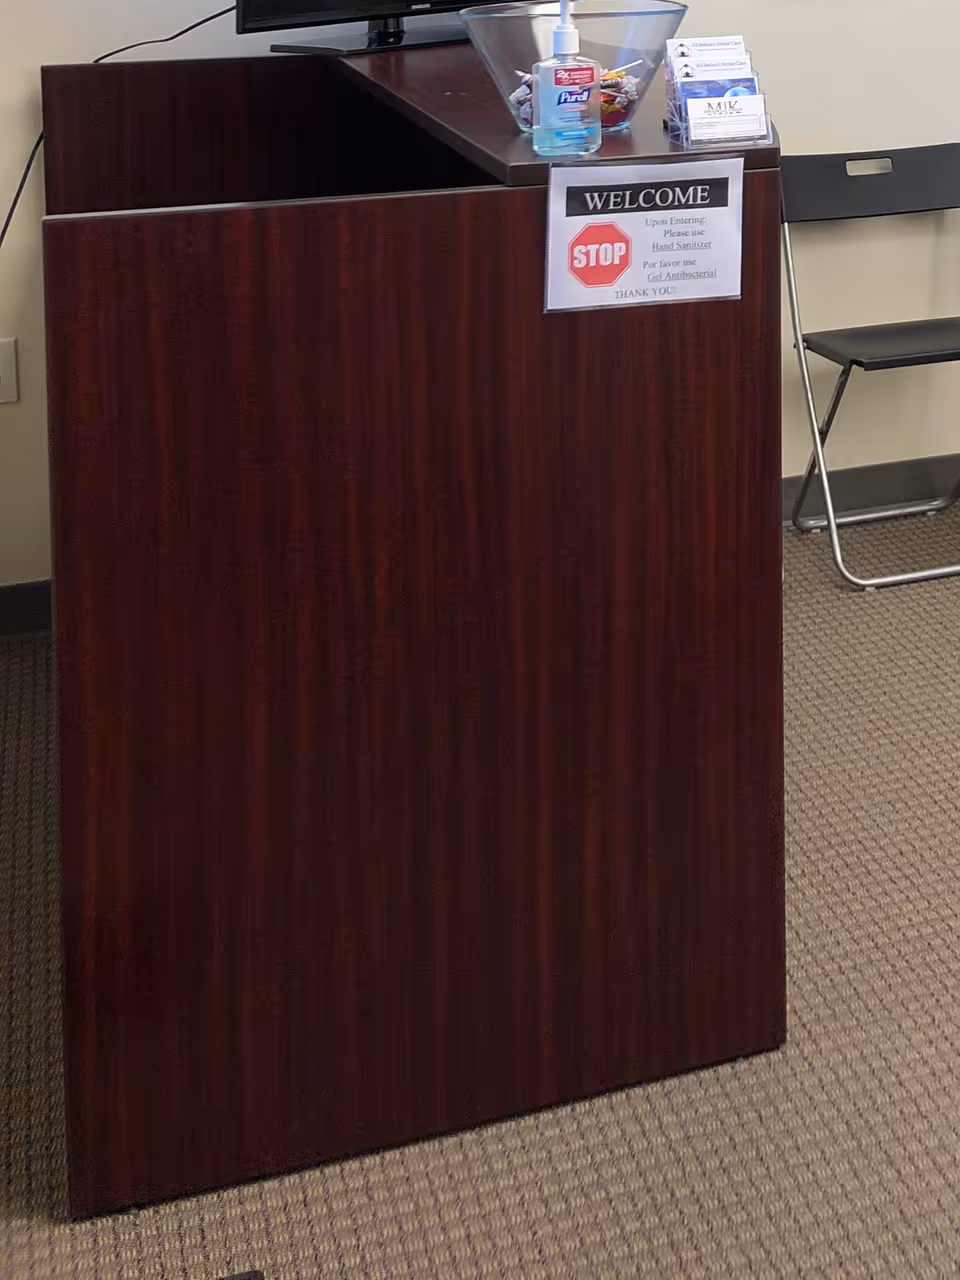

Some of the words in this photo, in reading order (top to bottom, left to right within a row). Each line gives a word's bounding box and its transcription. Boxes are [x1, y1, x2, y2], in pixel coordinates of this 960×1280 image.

[560, 91, 589, 103] Purell
[584, 185, 710, 211] WELCOME
[645, 218, 667, 228] Upon
[664, 229, 690, 238] Please
[691, 229, 705, 237] use
[652, 242, 674, 251] Hand
[676, 240, 712, 249] Sanitizer
[573, 242, 626, 268] STOP
[643, 261, 657, 269] Por
[659, 259, 681, 268] favor
[647, 272, 662, 281] Gel
[665, 268, 717, 280] Antibacterial
[615, 288, 648, 299] THANK
